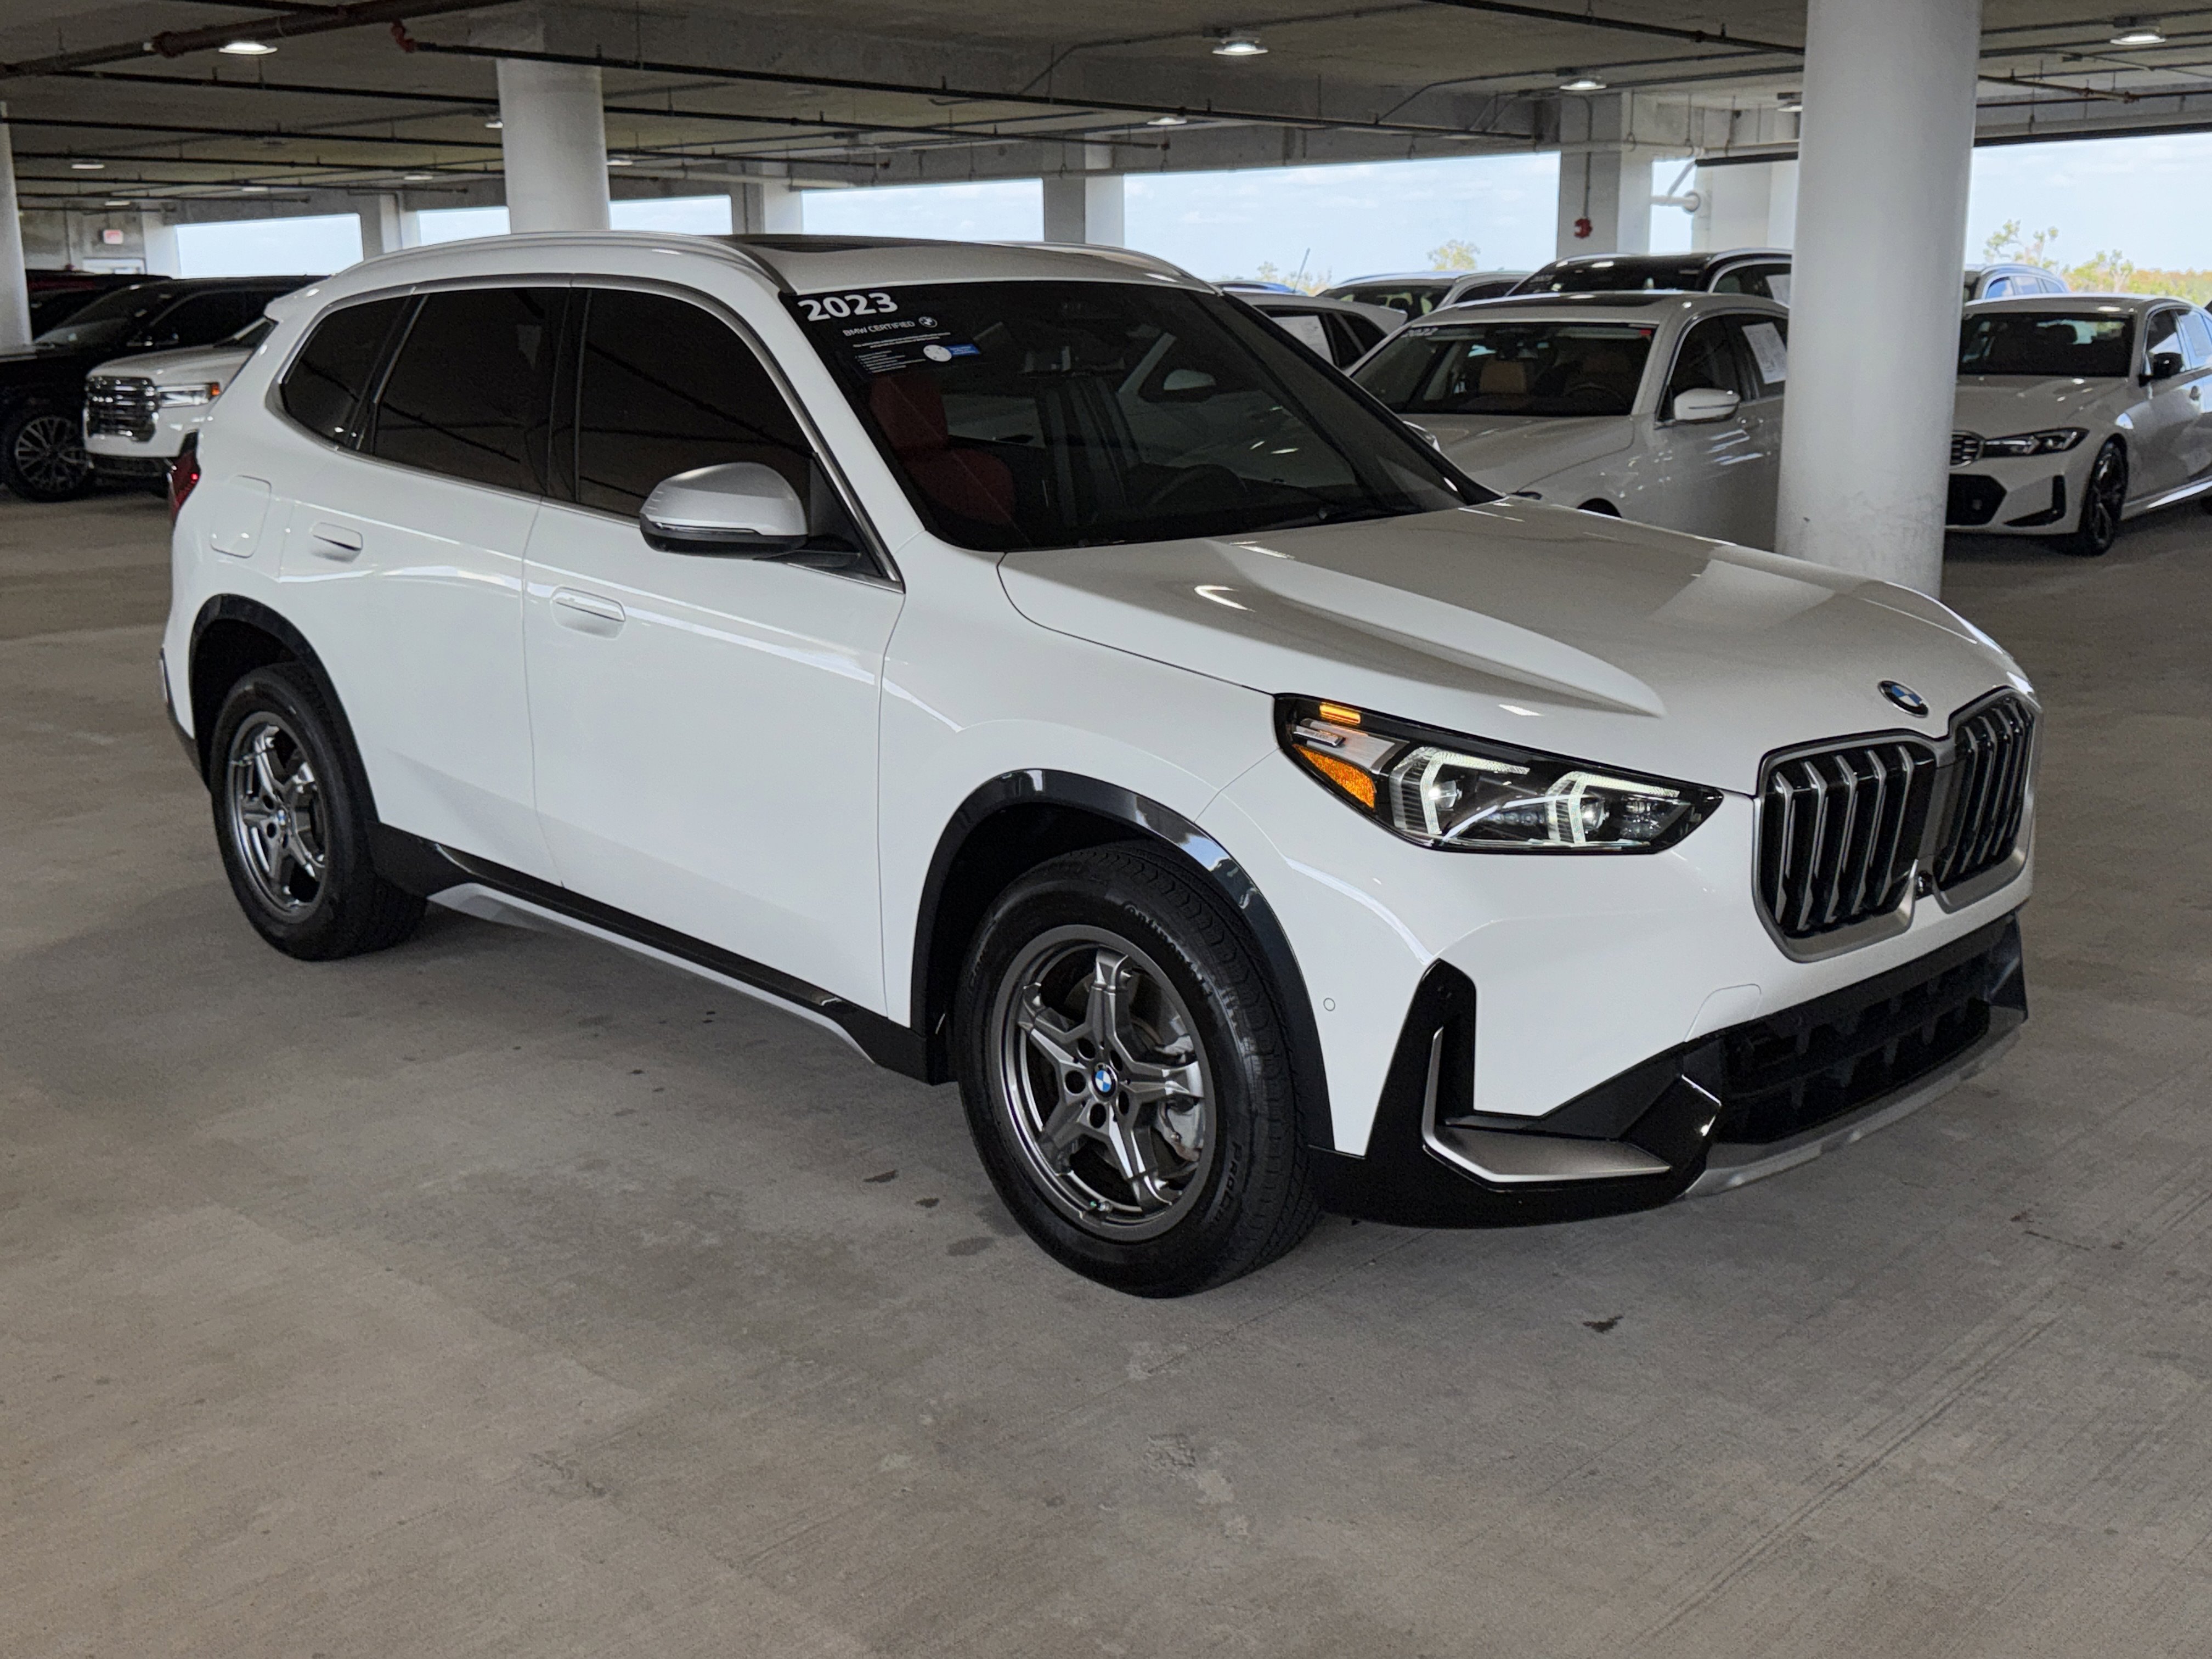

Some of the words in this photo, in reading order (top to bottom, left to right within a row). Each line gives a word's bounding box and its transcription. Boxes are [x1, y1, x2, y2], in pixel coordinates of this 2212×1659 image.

[797, 292, 898, 321] 2023
[843, 327, 867, 336] BMW
[868, 321, 916, 332] CERTIFIED
